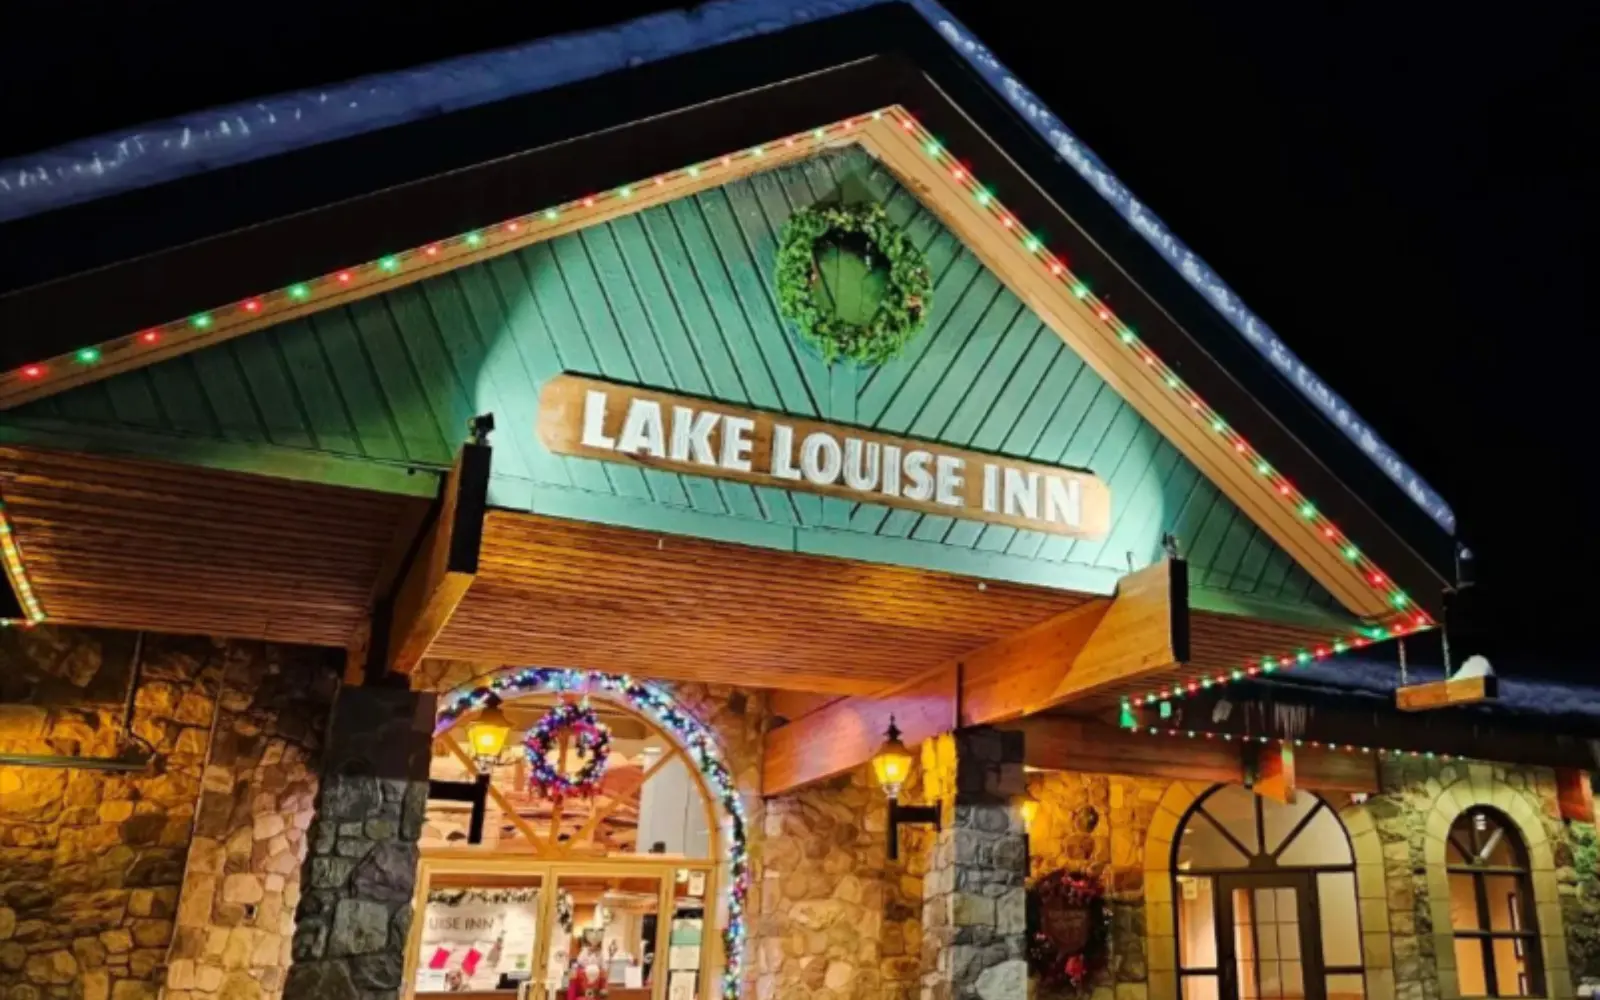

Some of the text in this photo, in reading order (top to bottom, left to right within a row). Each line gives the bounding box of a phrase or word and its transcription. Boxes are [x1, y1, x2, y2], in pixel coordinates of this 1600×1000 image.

[581, 390, 1081, 526] LAKE LOUISE INN
